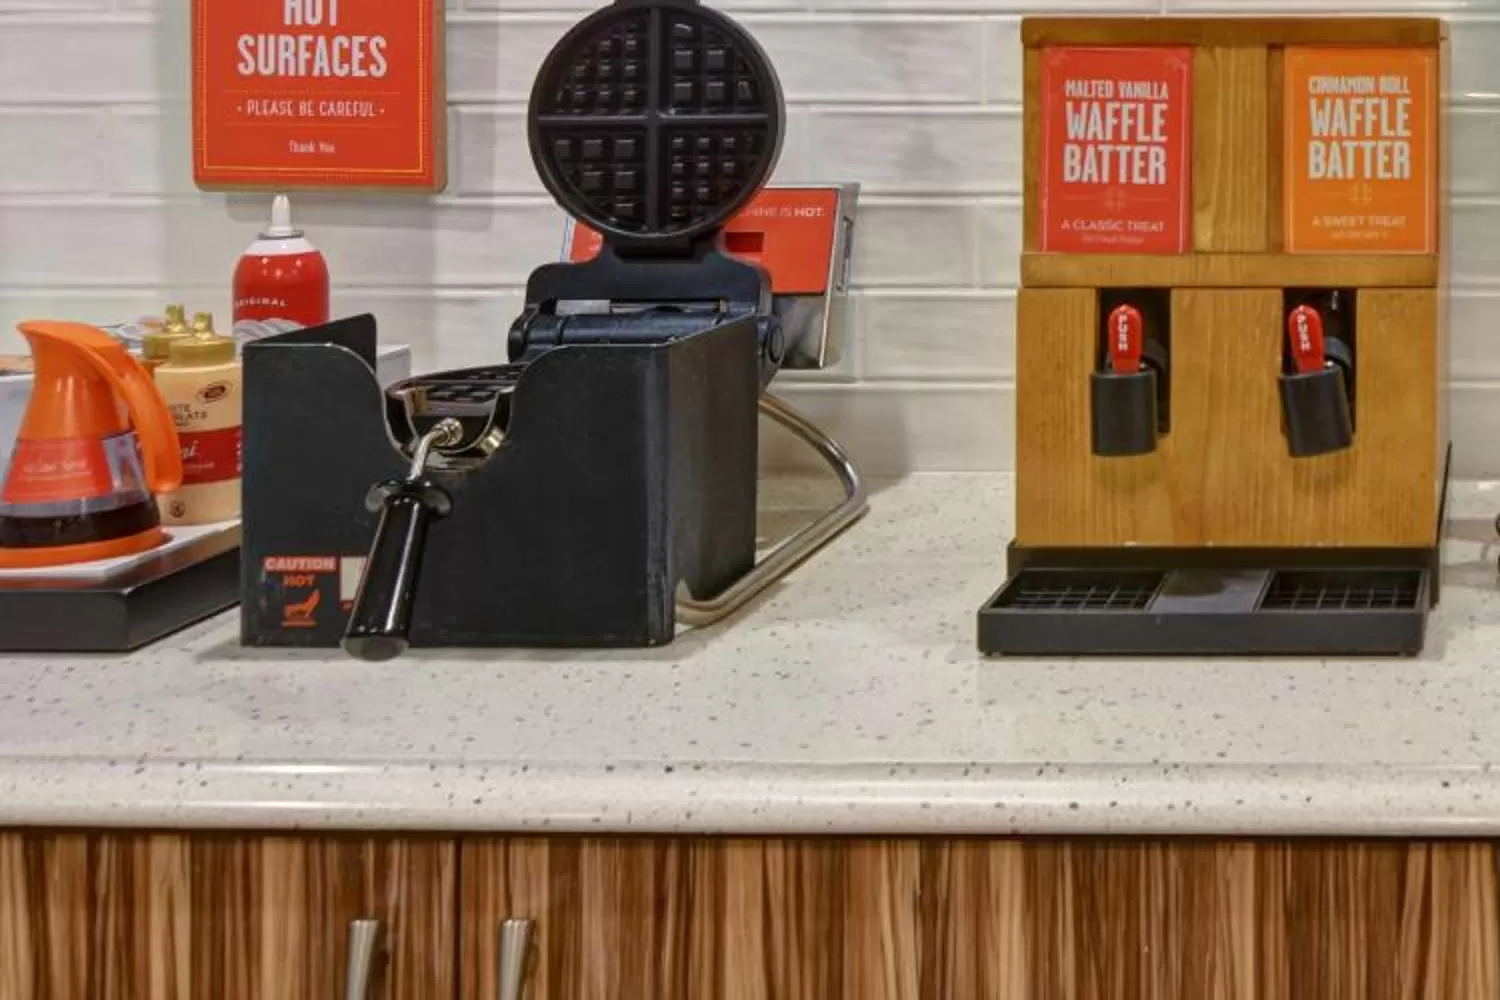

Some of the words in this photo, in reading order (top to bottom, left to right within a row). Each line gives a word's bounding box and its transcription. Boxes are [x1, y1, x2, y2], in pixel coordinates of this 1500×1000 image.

[237, 34, 387, 77] SURFACES
[1066, 79, 1113, 98] MALTED
[1119, 81, 1168, 100] VANILLA
[1308, 76, 1375, 93] CINNAMON
[247, 99, 294, 116] PLEASE
[299, 100, 316, 117] BE
[319, 100, 376, 117] CAREFUL
[1309, 97, 1412, 136] WAFFLE
[1066, 101, 1168, 142] WAFFLE
[289, 139, 316, 153] Thank
[1063, 144, 1166, 184] BATTER
[1308, 140, 1410, 180] BATTER
[1061, 219, 1070, 230] A
[1073, 219, 1123, 232] CLASSIC
[1128, 220, 1164, 232] TREAT
[265, 557, 336, 571] CAUTION
